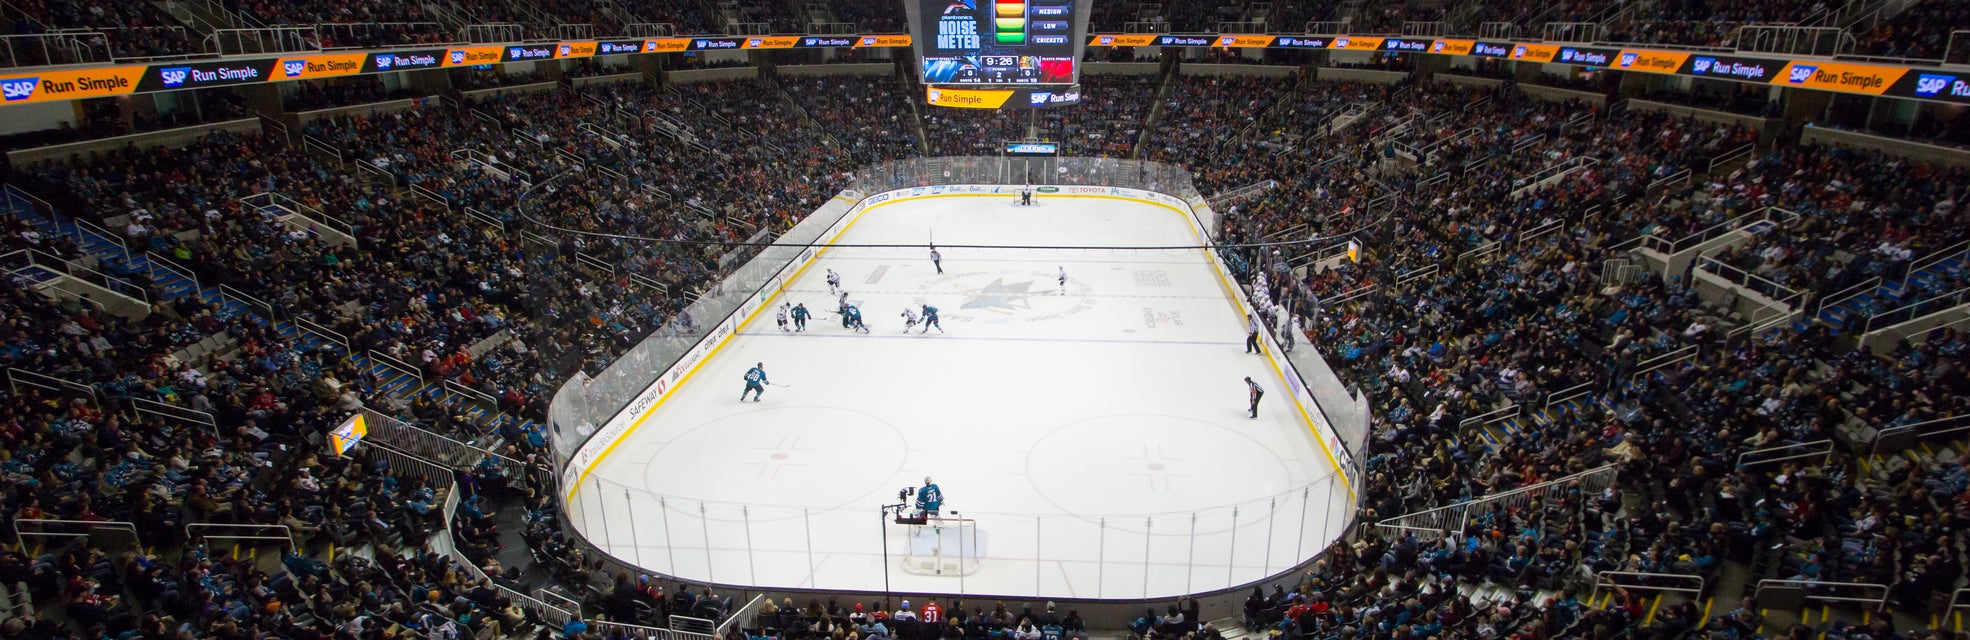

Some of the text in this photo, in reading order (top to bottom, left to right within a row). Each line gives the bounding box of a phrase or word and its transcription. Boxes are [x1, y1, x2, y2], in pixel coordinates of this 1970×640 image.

[938, 20, 977, 35] NOISE
[718, 40, 736, 48] Simple
[775, 39, 792, 47] Simple
[830, 38, 849, 46] Simple
[937, 35, 980, 49] METER
[1304, 39, 1322, 47] Simple
[1411, 42, 1425, 50] Simple
[511, 50, 521, 58] SAP
[533, 49, 550, 57] Simple
[580, 46, 593, 54] Simple
[623, 44, 637, 52] Simple
[1454, 44, 1467, 52] Simple
[1494, 46, 1506, 55] Simple
[1515, 48, 1550, 58] SAP Run Simple
[377, 55, 435, 67] SAP Run Simple
[452, 51, 497, 62] SAP Run Simple
[986, 57, 1013, 66] 9:26
[1562, 51, 1606, 64] SAP Run Simple
[1622, 55, 1675, 69] SAP Run Simple
[285, 59, 357, 76] SAP Run Simple
[1694, 61, 1764, 78] SAP Run Simple
[162, 67, 258, 84] SAP Run Simple
[1791, 68, 1883, 89] SAP Run Simple
[2, 75, 128, 98] SAP Run Simple
[1917, 78, 1970, 95] SAP Ru
[940, 94, 952, 102] Run
[954, 95, 981, 105] Simple
[1031, 92, 1079, 104] SAP Run Simpl
[868, 194, 889, 205] GEICO
[629, 387, 658, 420] SAFEWAY
[925, 611, 937, 623] 31
